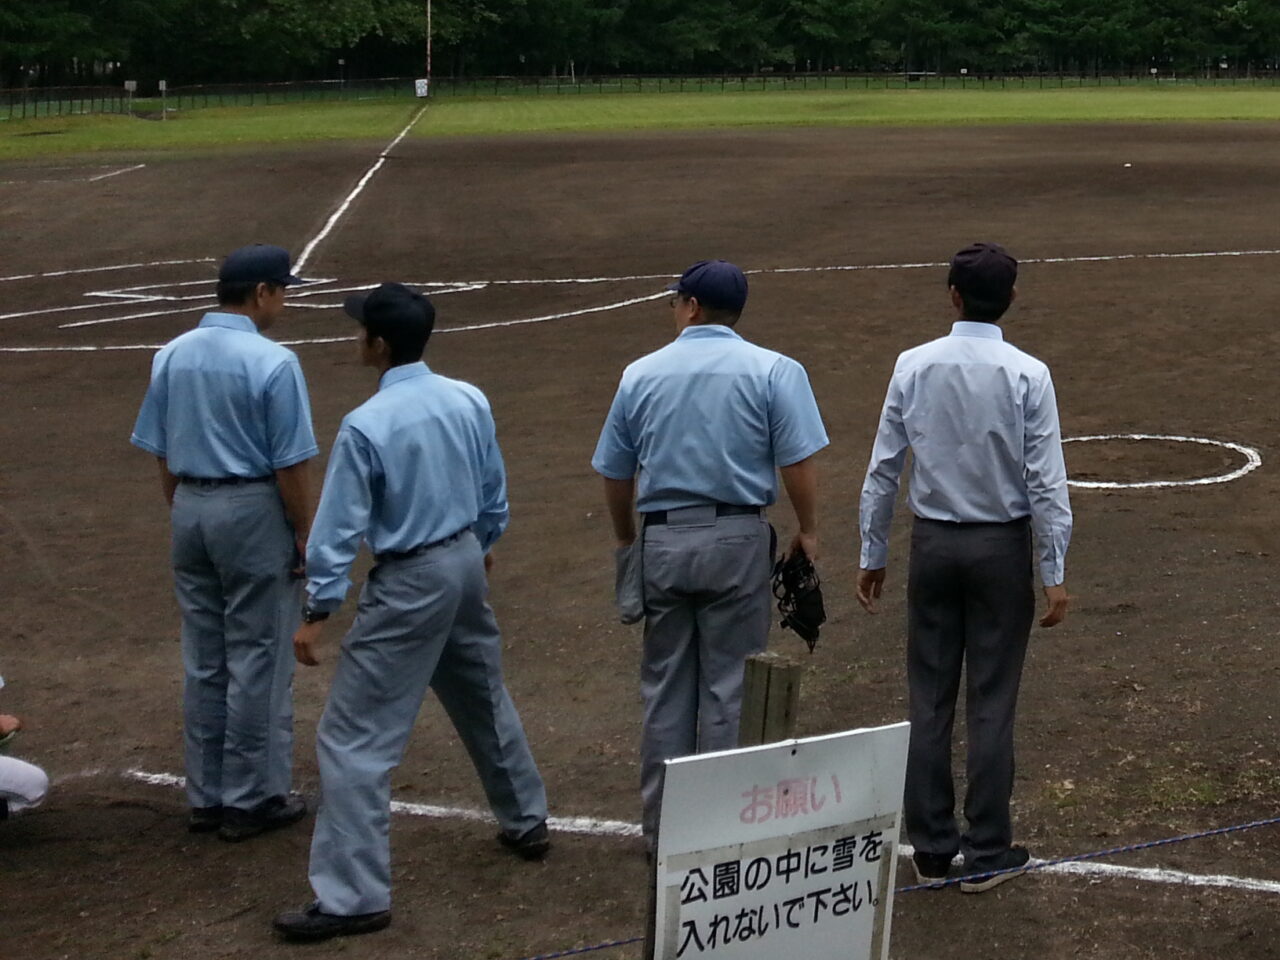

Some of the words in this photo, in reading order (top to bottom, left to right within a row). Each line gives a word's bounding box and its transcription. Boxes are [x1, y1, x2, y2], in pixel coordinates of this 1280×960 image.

[739, 774, 842, 824] お願い
[680, 830, 883, 906] 公園の中に雪を
[676, 879, 879, 958] 入れないで下さい。
